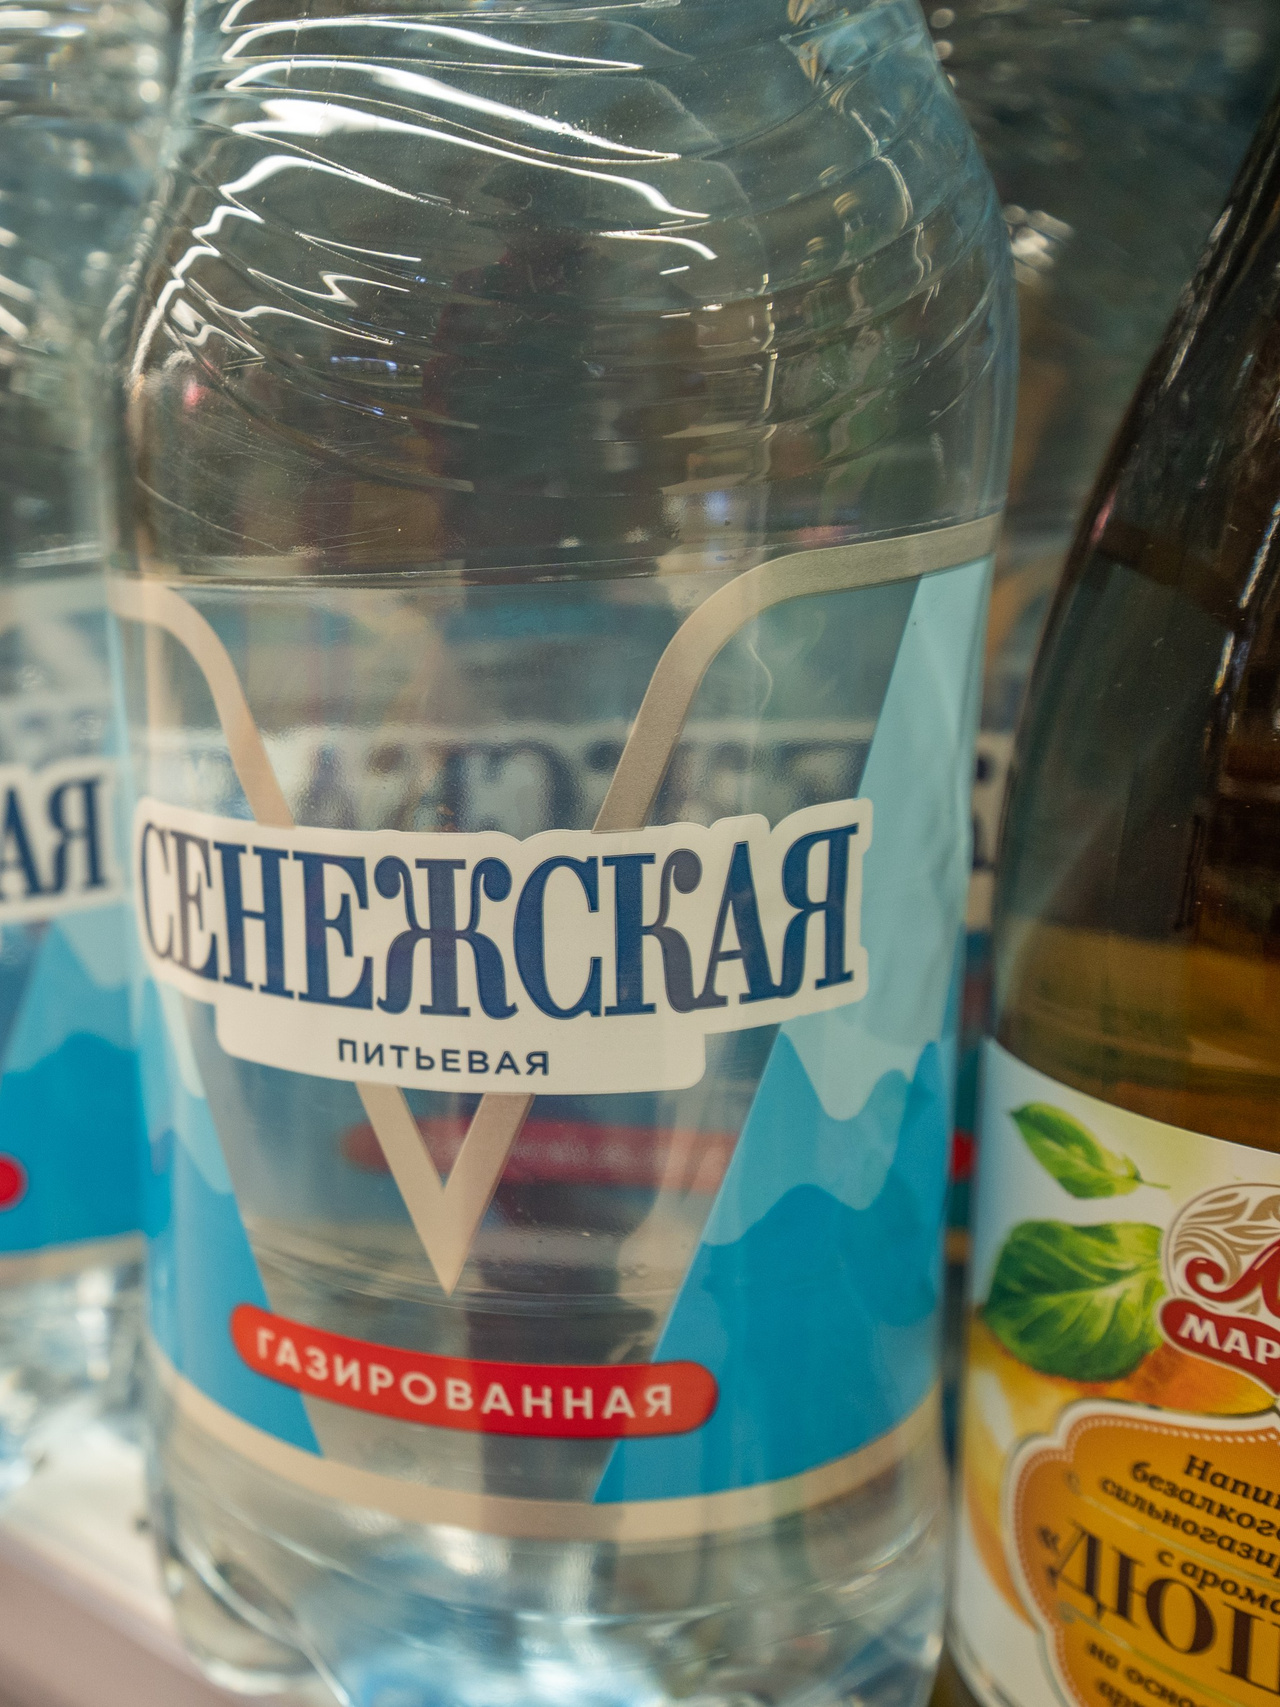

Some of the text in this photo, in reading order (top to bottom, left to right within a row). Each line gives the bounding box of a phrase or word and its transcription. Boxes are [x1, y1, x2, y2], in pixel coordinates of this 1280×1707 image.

[139, 821, 860, 1020] СЕНЕЖСКАЯ
[338, 1038, 550, 1076] ПИТЬЕВАЯ
[256, 1327, 673, 1420] ГАЗИРОВАННАЯ
[1183, 1453, 1280, 1511] Напи
[1157, 1550, 1175, 1567] с
